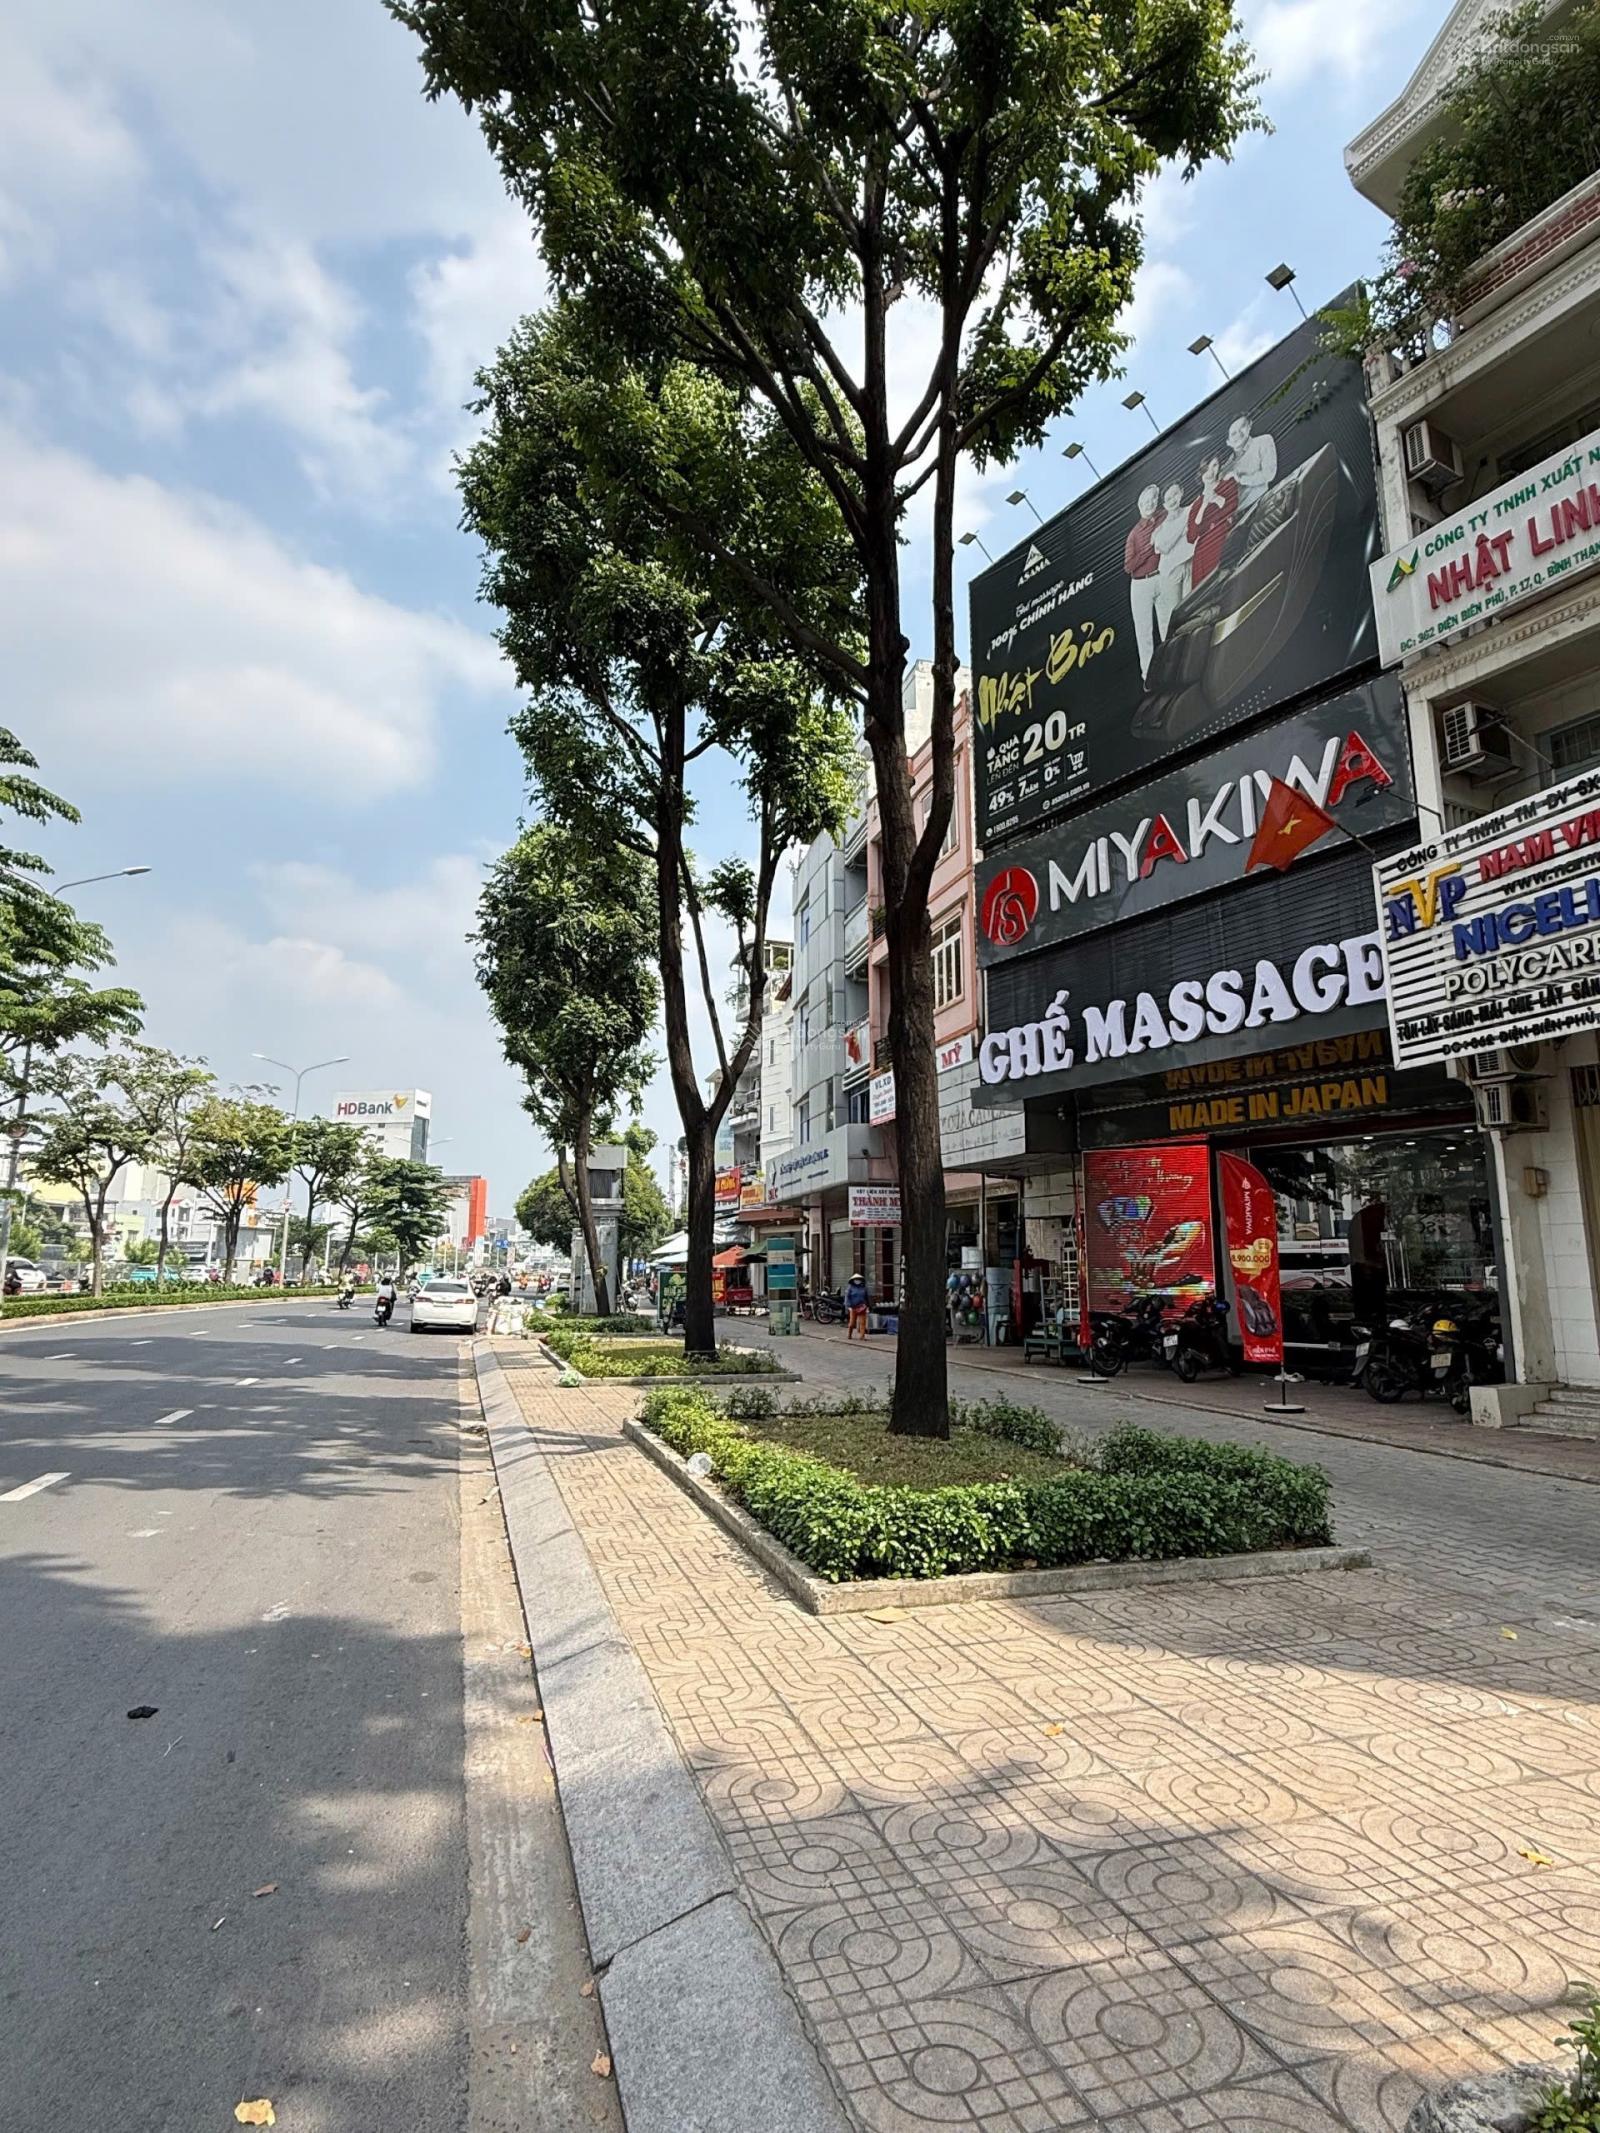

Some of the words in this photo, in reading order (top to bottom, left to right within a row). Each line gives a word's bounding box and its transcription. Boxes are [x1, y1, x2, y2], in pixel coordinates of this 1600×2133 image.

[1425, 525, 1464, 557] CÔNG
[1468, 510, 1488, 533] TY
[1493, 484, 1537, 518] TNHH
[1541, 454, 1583, 493] XUẤT
[1017, 557, 1052, 588] ASAMA
[1427, 529, 1514, 611] NHẬT
[1437, 614, 1459, 635] ĐIỆN
[1460, 600, 1483, 622] BIÊN
[1547, 558, 1572, 579] BÌNH
[987, 624, 1019, 658] 100%
[1019, 595, 1056, 631] CHÍNH
[1057, 571, 1095, 605] HÃNG
[999, 734, 1020, 754] QUÀ
[1022, 710, 1067, 766] 20
[1067, 722, 1086, 740] TR
[988, 790, 1015, 811] 49%
[1044, 765, 1060, 782] 0%
[1049, 730, 1394, 913] MIYAKIWA
[1395, 844, 1438, 872] CÔNG
[1443, 833, 1461, 853] TY
[1467, 814, 1507, 843] TNHH
[1514, 801, 1538, 823] TM
[1547, 786, 1569, 810] DV
[1479, 828, 1554, 883] NAM
[1388, 862, 1468, 941] NVP
[979, 989, 1075, 1085] GHẾ
[1081, 930, 1388, 1063] MASSAGE
[940, 1041, 963, 1069] MỸ
[337, 1100, 393, 1117] HDBank
[1169, 1096, 1245, 1131] MADE
[1248, 1091, 1278, 1121] IN
[1283, 1075, 1388, 1116] JAPAN
[1241, 1190, 1255, 1236] MIYAKIWA
